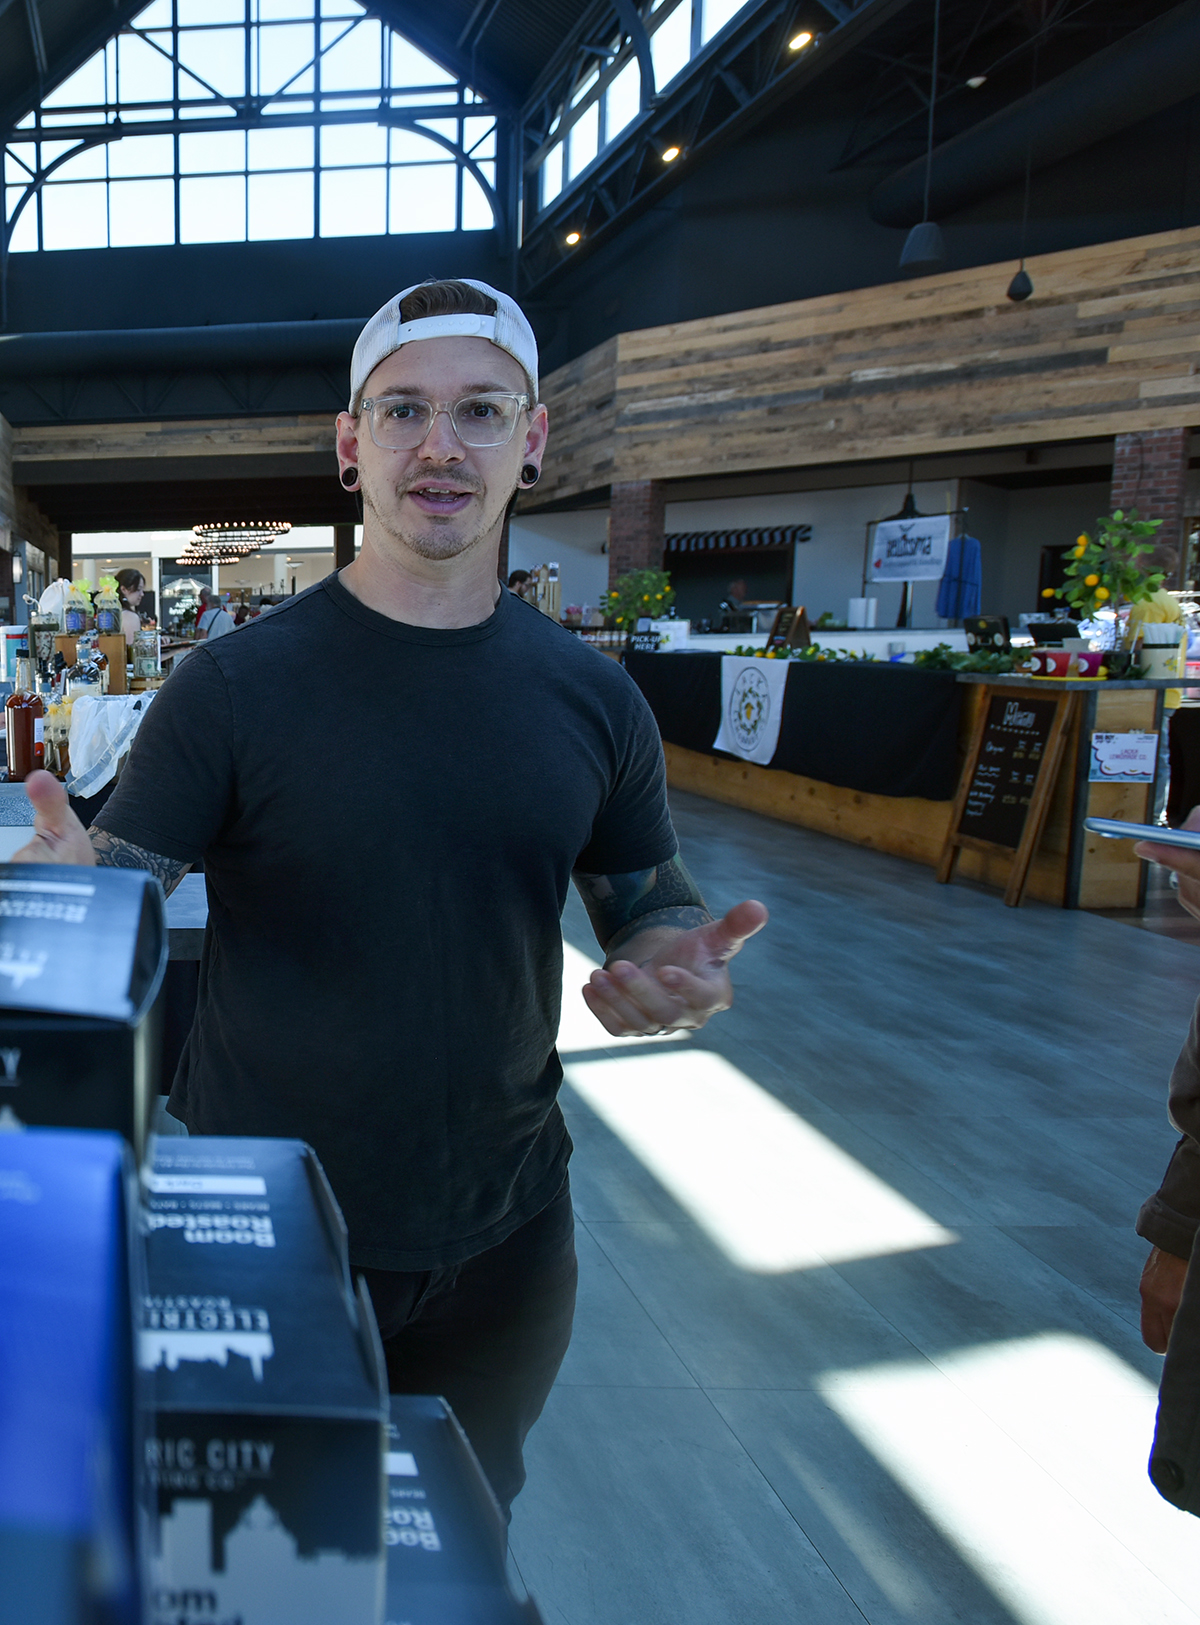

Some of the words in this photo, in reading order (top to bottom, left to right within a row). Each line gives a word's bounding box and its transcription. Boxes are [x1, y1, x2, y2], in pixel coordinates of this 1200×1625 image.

[634, 642, 657, 651] HERE
[1002, 701, 1036, 728] Menu
[148, 1213, 273, 1234] Roasted
[184, 1229, 276, 1248] Boom
[206, 1439, 275, 1473] CITY
